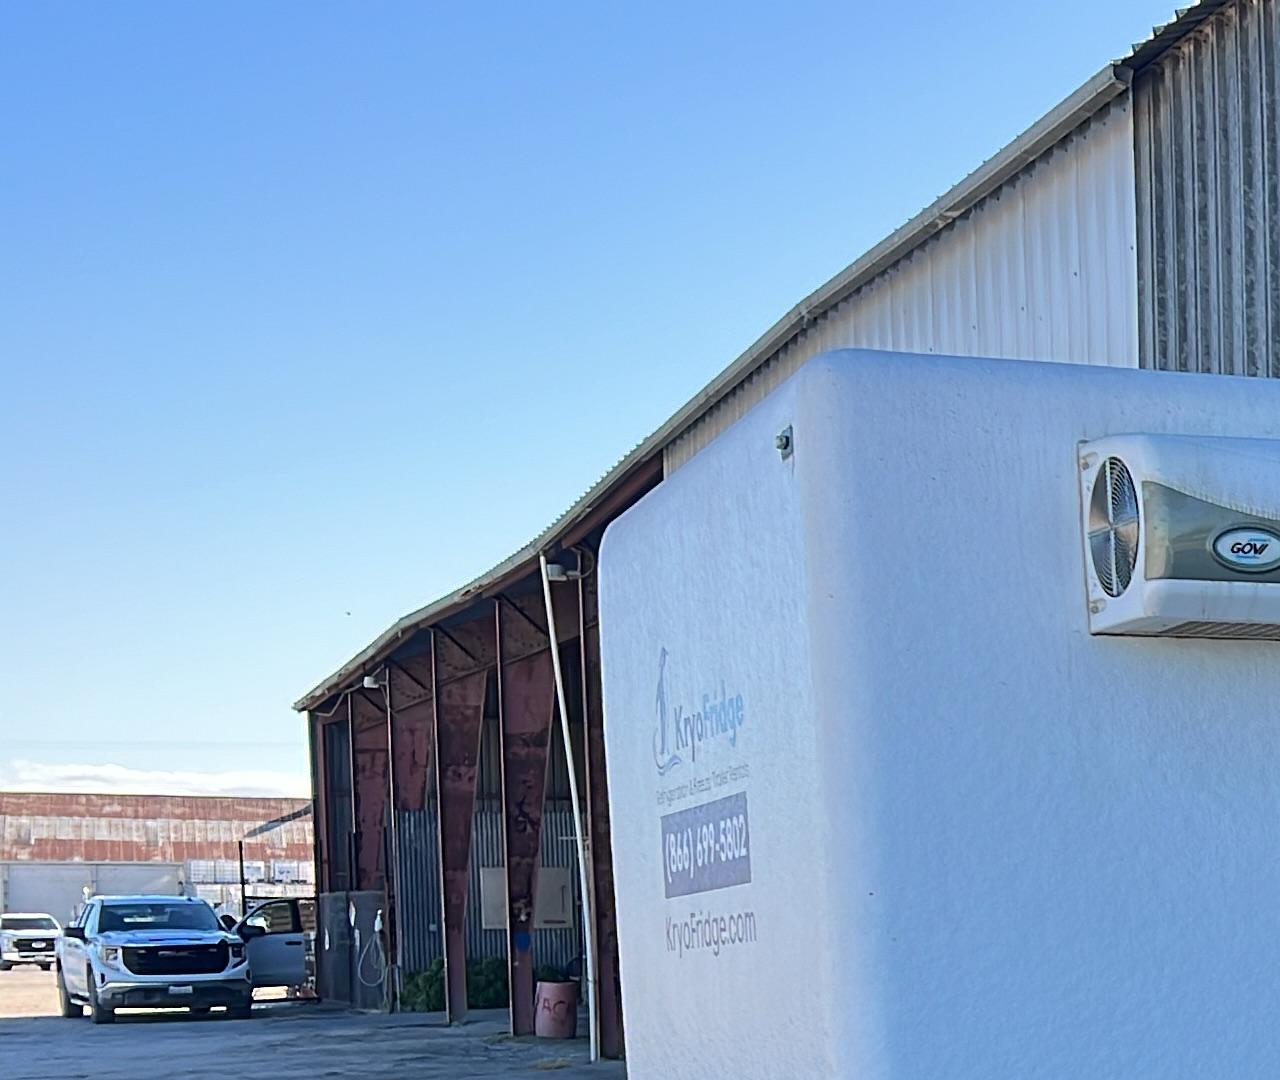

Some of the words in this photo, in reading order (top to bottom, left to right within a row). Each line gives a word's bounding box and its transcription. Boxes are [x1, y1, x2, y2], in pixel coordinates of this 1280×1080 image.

[673, 680, 745, 762] KryoFridge
[664, 826, 695, 883] (866)
[696, 813, 748, 867] 699-5802
[664, 909, 758, 958] KryoFridge.com
